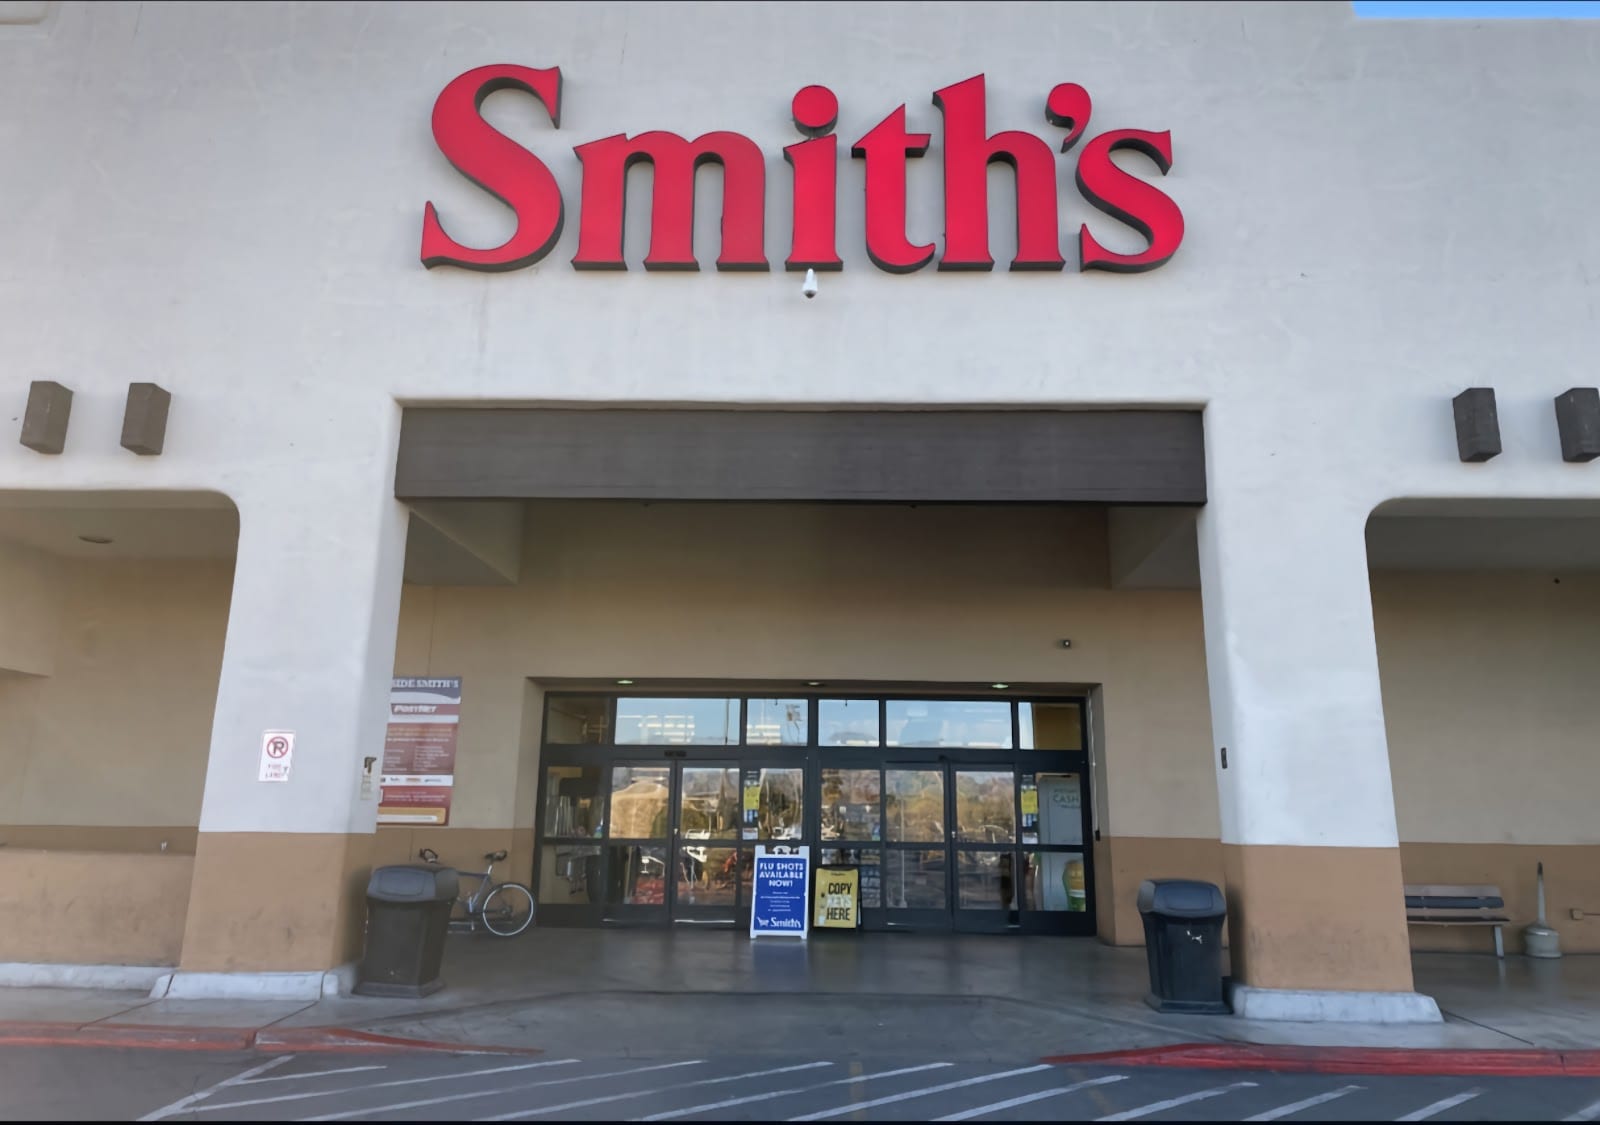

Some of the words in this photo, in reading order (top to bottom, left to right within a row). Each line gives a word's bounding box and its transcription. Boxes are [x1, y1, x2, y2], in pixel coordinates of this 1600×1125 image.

[420, 64, 1185, 272] Smith's
[759, 862, 774, 871] FLU
[776, 862, 804, 871] SHOTS
[759, 871, 803, 879] AVAILABLE
[768, 879, 793, 887] NOW!
[828, 882, 853, 895] COPY
[826, 907, 851, 921] HERE
